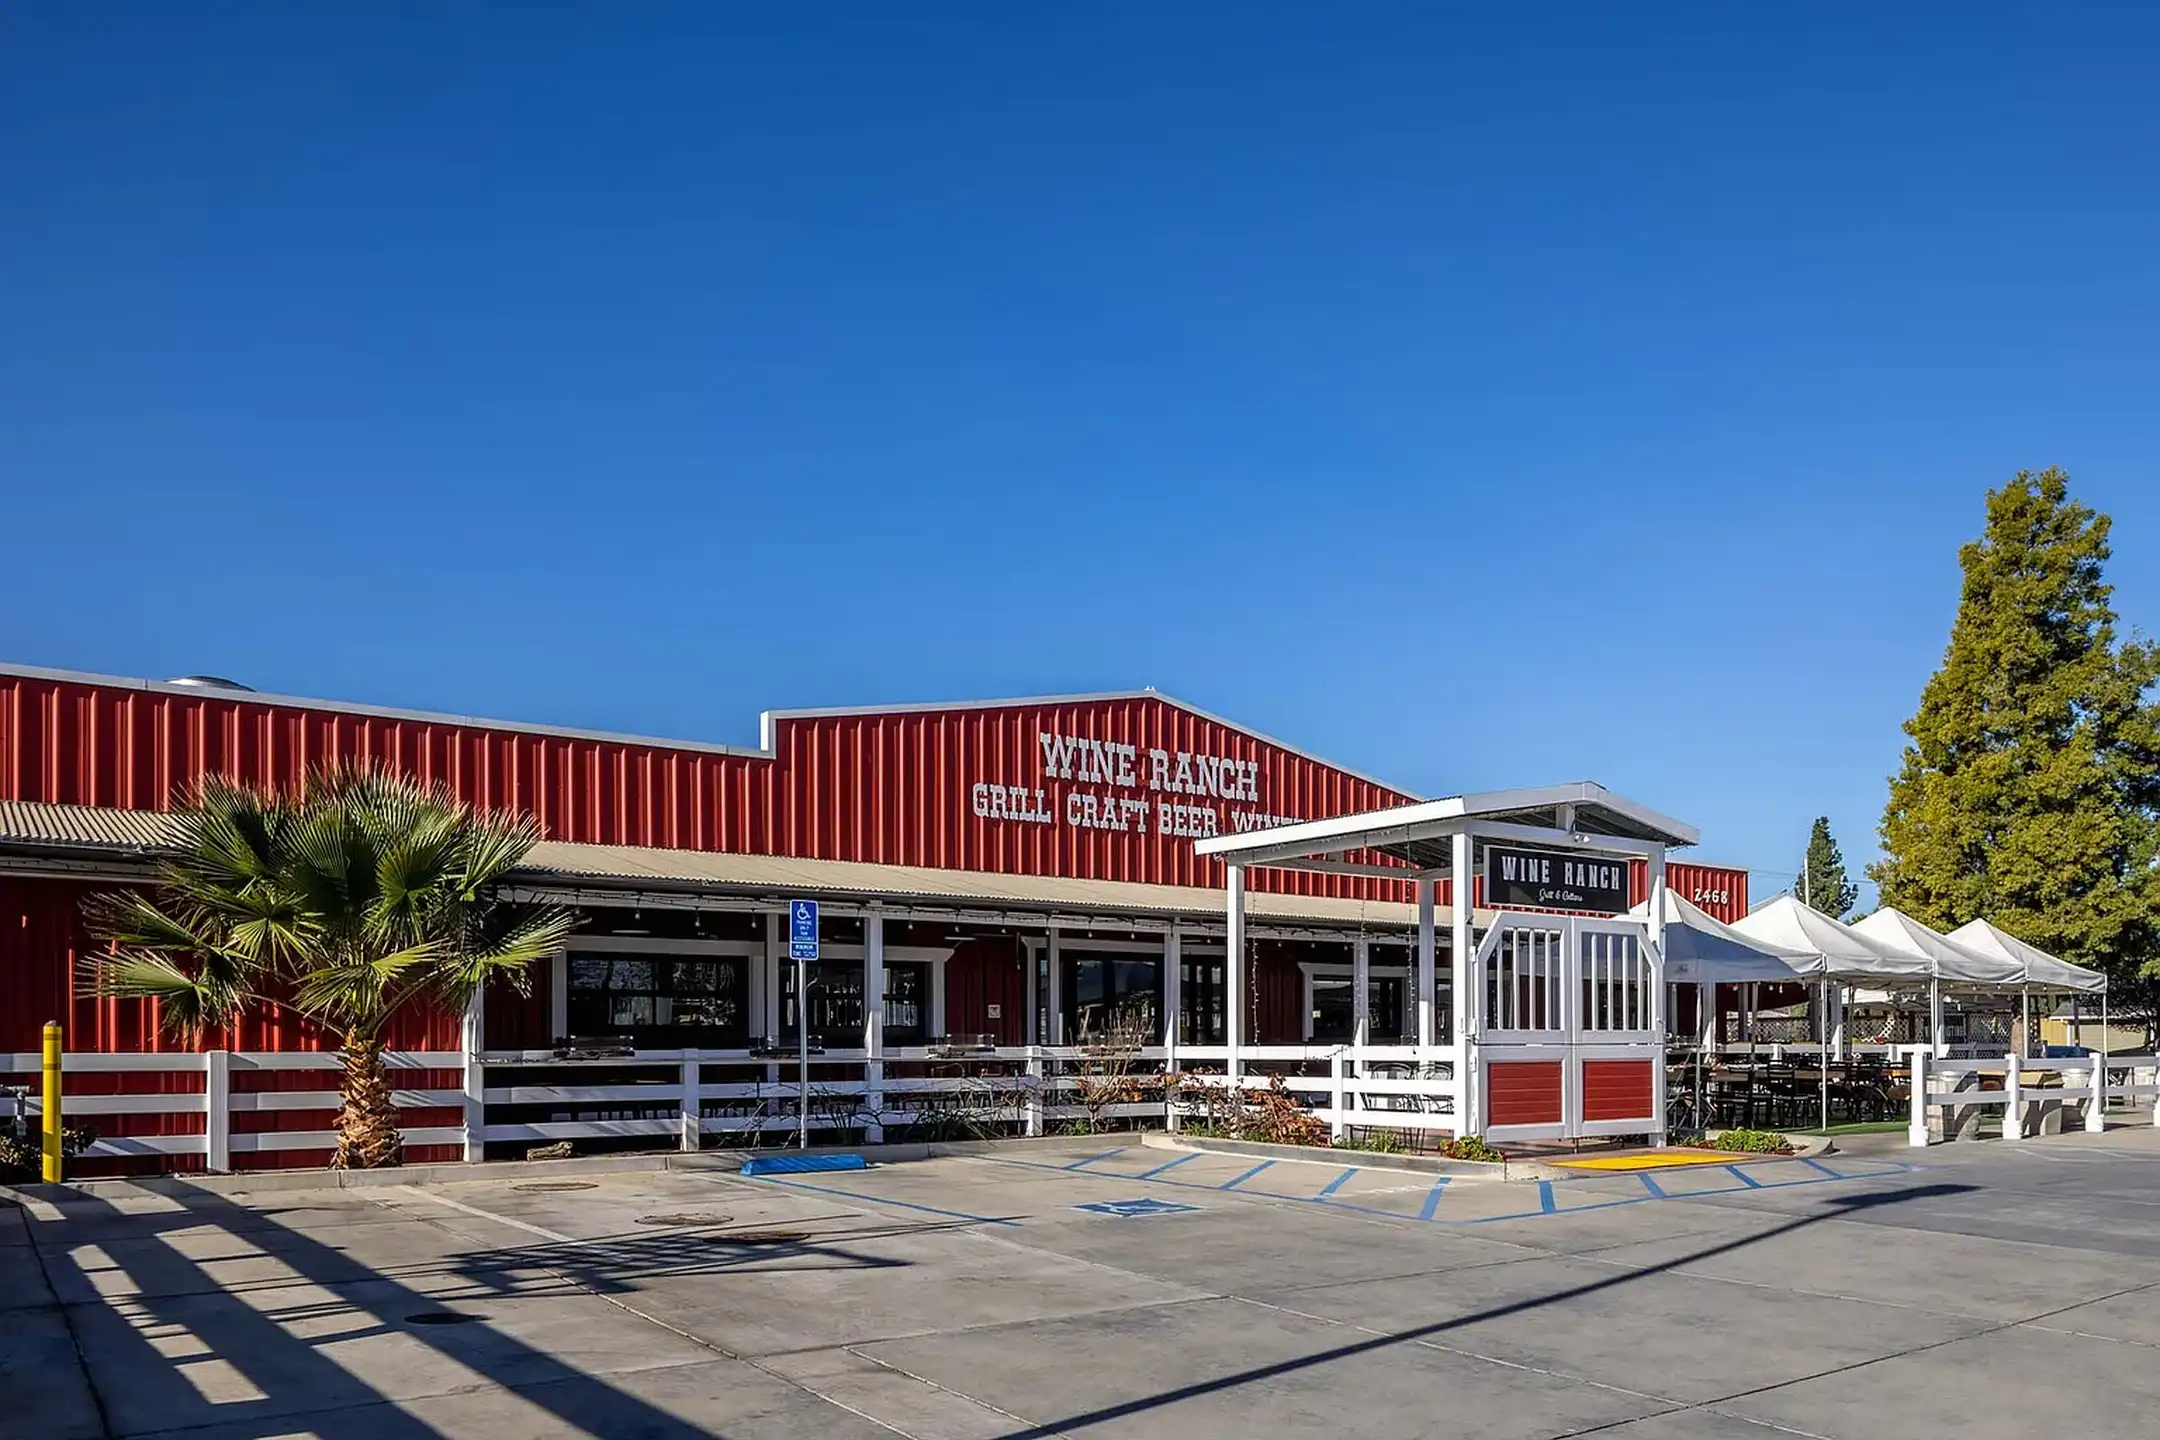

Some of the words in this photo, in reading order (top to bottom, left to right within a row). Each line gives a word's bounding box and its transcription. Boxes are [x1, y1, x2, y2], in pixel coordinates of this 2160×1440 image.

[1039, 731, 1136, 787] WINE
[1150, 748, 1258, 802] RANCH
[972, 782, 1051, 824] GRILL
[1067, 792, 1149, 833] CRAFT
[1158, 802, 1219, 838] BEER
[1501, 855, 1550, 884] WINE
[1564, 861, 1620, 890] RANCH
[1694, 888, 1728, 904] 2468
